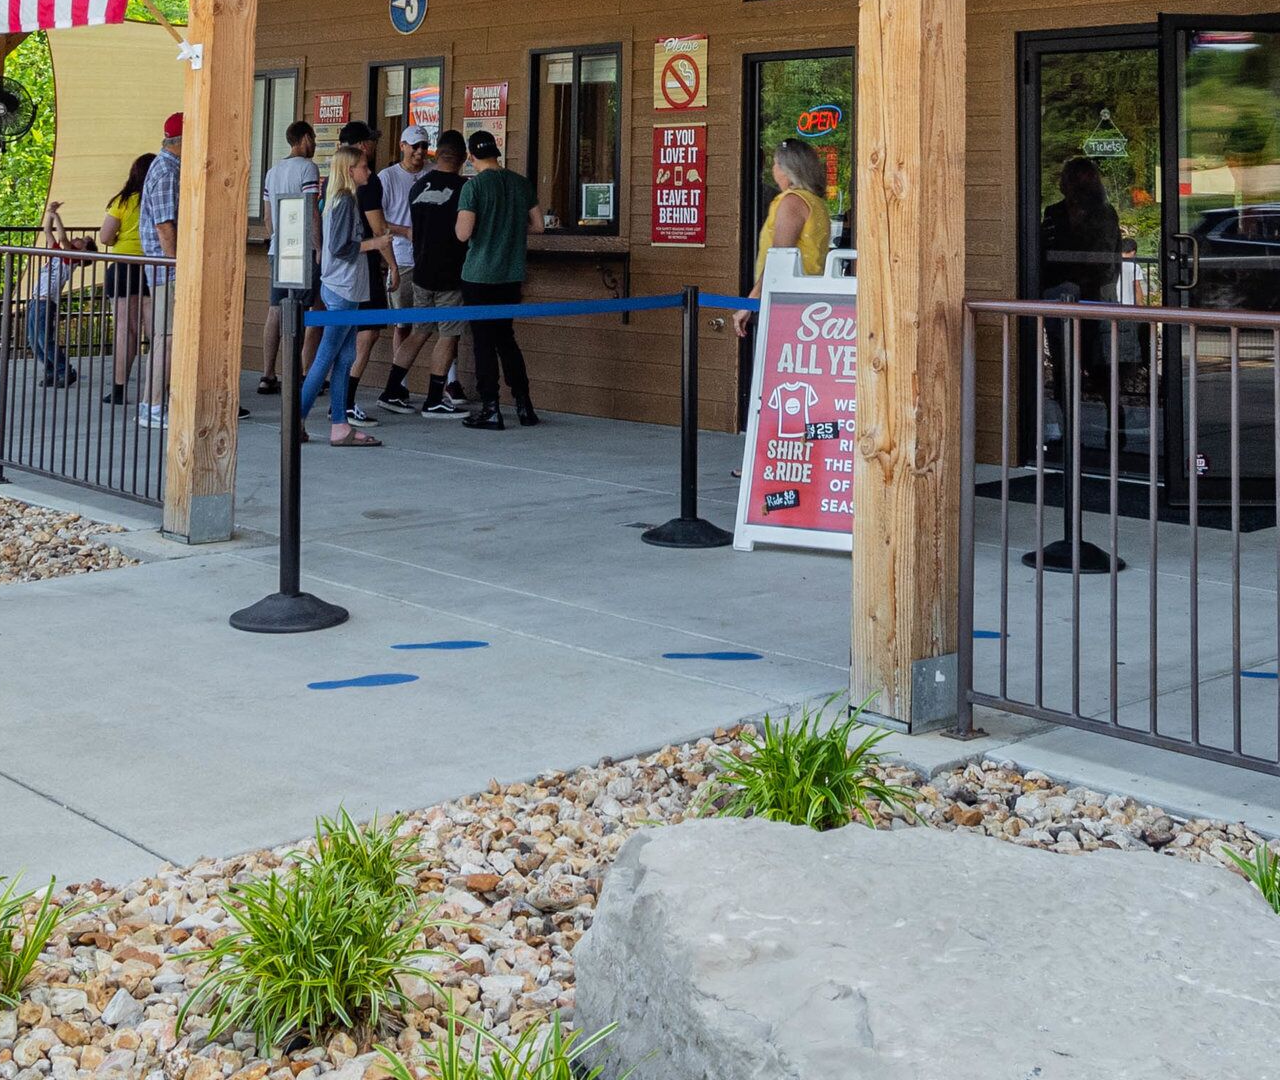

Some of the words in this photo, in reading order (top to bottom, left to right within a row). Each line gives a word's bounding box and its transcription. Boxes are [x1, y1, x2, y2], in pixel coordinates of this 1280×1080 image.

[664, 38, 698, 53] Please
[472, 86, 501, 98] RUNAWAY
[471, 99, 500, 111] COASTER
[798, 111, 839, 131] OPEN
[664, 130, 673, 146] IF
[675, 129, 695, 145] YOU
[1090, 141, 1121, 152] Tickets
[660, 147, 685, 163] LOVE
[687, 147, 698, 163] IT
[656, 189, 688, 206] LEAVE
[690, 189, 701, 206] IT
[659, 207, 698, 224] BEHIND
[796, 301, 857, 342] Sav
[777, 343, 822, 375] ALL
[827, 345, 856, 376] YE
[834, 399, 856, 412] WE
[810, 422, 833, 438] $25
[837, 419, 855, 432] FO
[767, 439, 814, 461] SHIRT
[824, 458, 852, 472] THE
[829, 479, 850, 492] OF
[766, 493, 783, 507] Ride
[820, 498, 854, 513] SEAS
